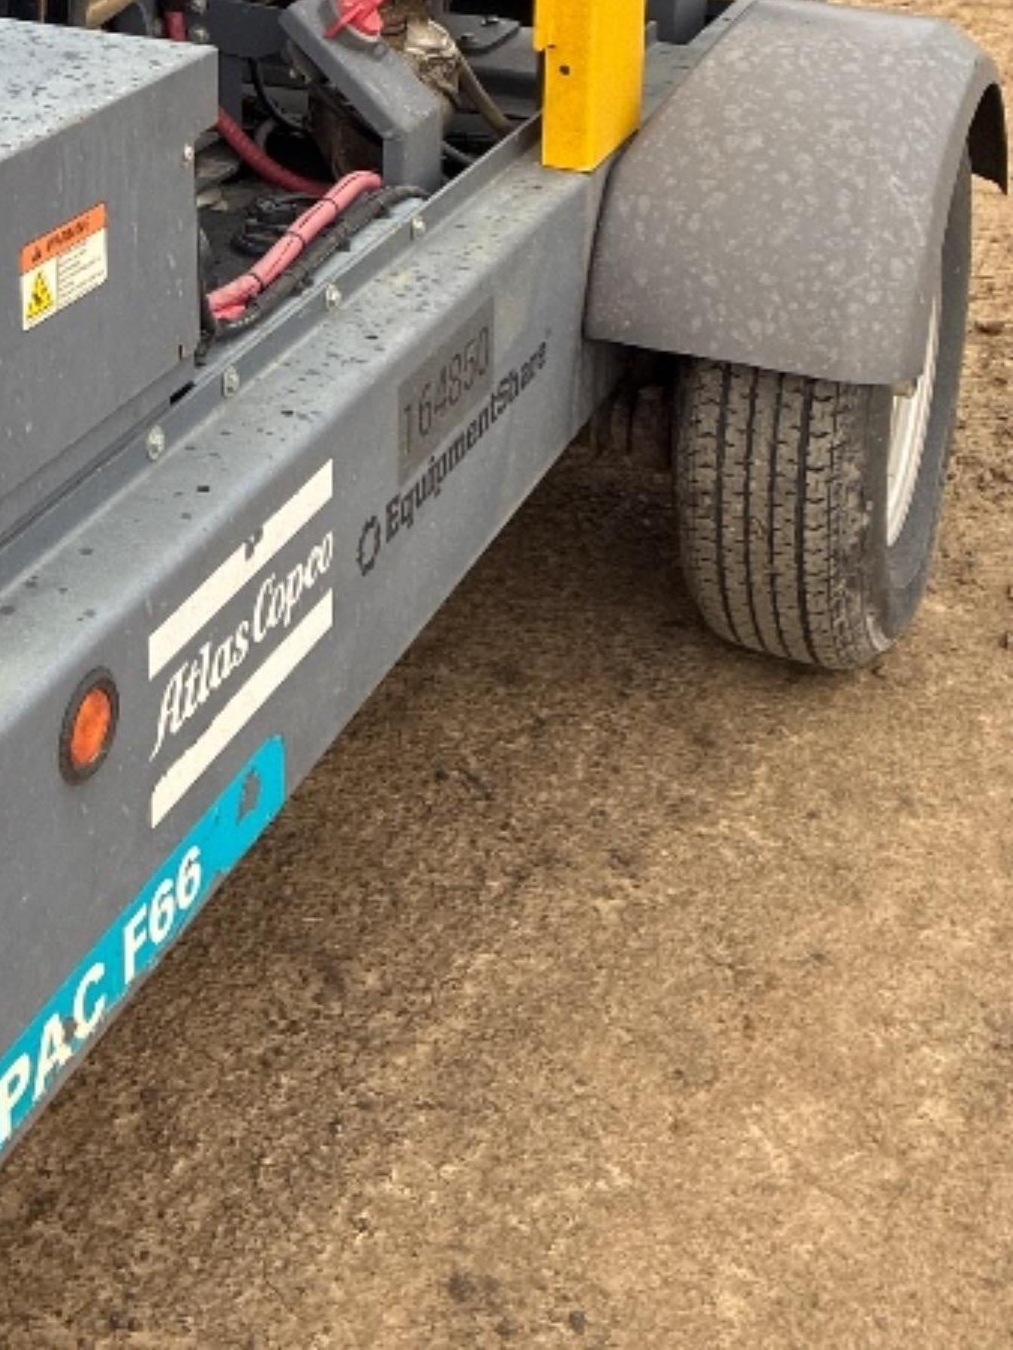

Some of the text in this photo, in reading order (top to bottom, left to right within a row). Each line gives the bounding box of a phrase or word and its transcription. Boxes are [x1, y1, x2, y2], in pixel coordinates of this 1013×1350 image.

[386, 340, 547, 544] EquipmentShare
[148, 530, 334, 762] Atlas Copco
[123, 845, 202, 986] F66
